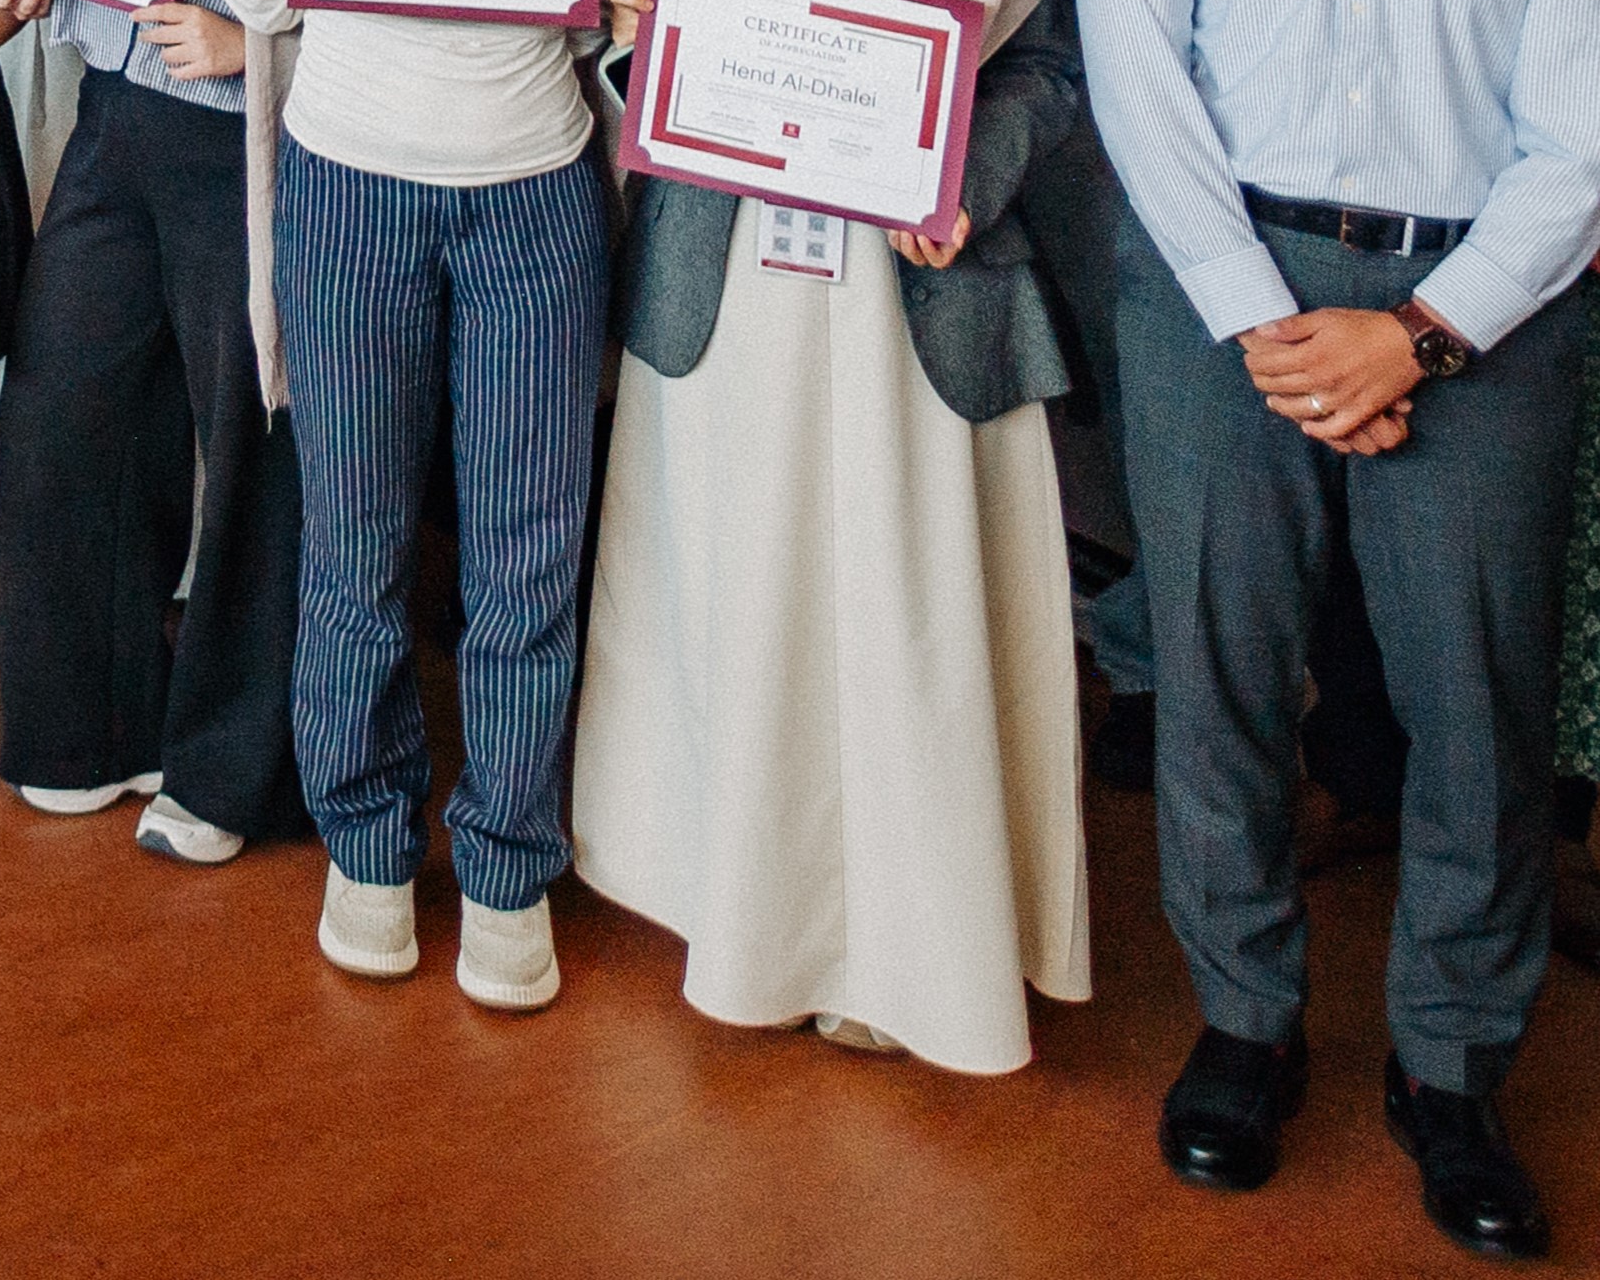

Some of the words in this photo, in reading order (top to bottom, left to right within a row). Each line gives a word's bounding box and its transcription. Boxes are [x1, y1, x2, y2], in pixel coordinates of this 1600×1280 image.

[744, 15, 869, 55] CERTIFICATE
[759, 39, 772, 47] OF
[773, 41, 848, 64] APPRECIATION
[721, 57, 776, 86] Hend
[782, 67, 878, 109] Al-Dhalei
